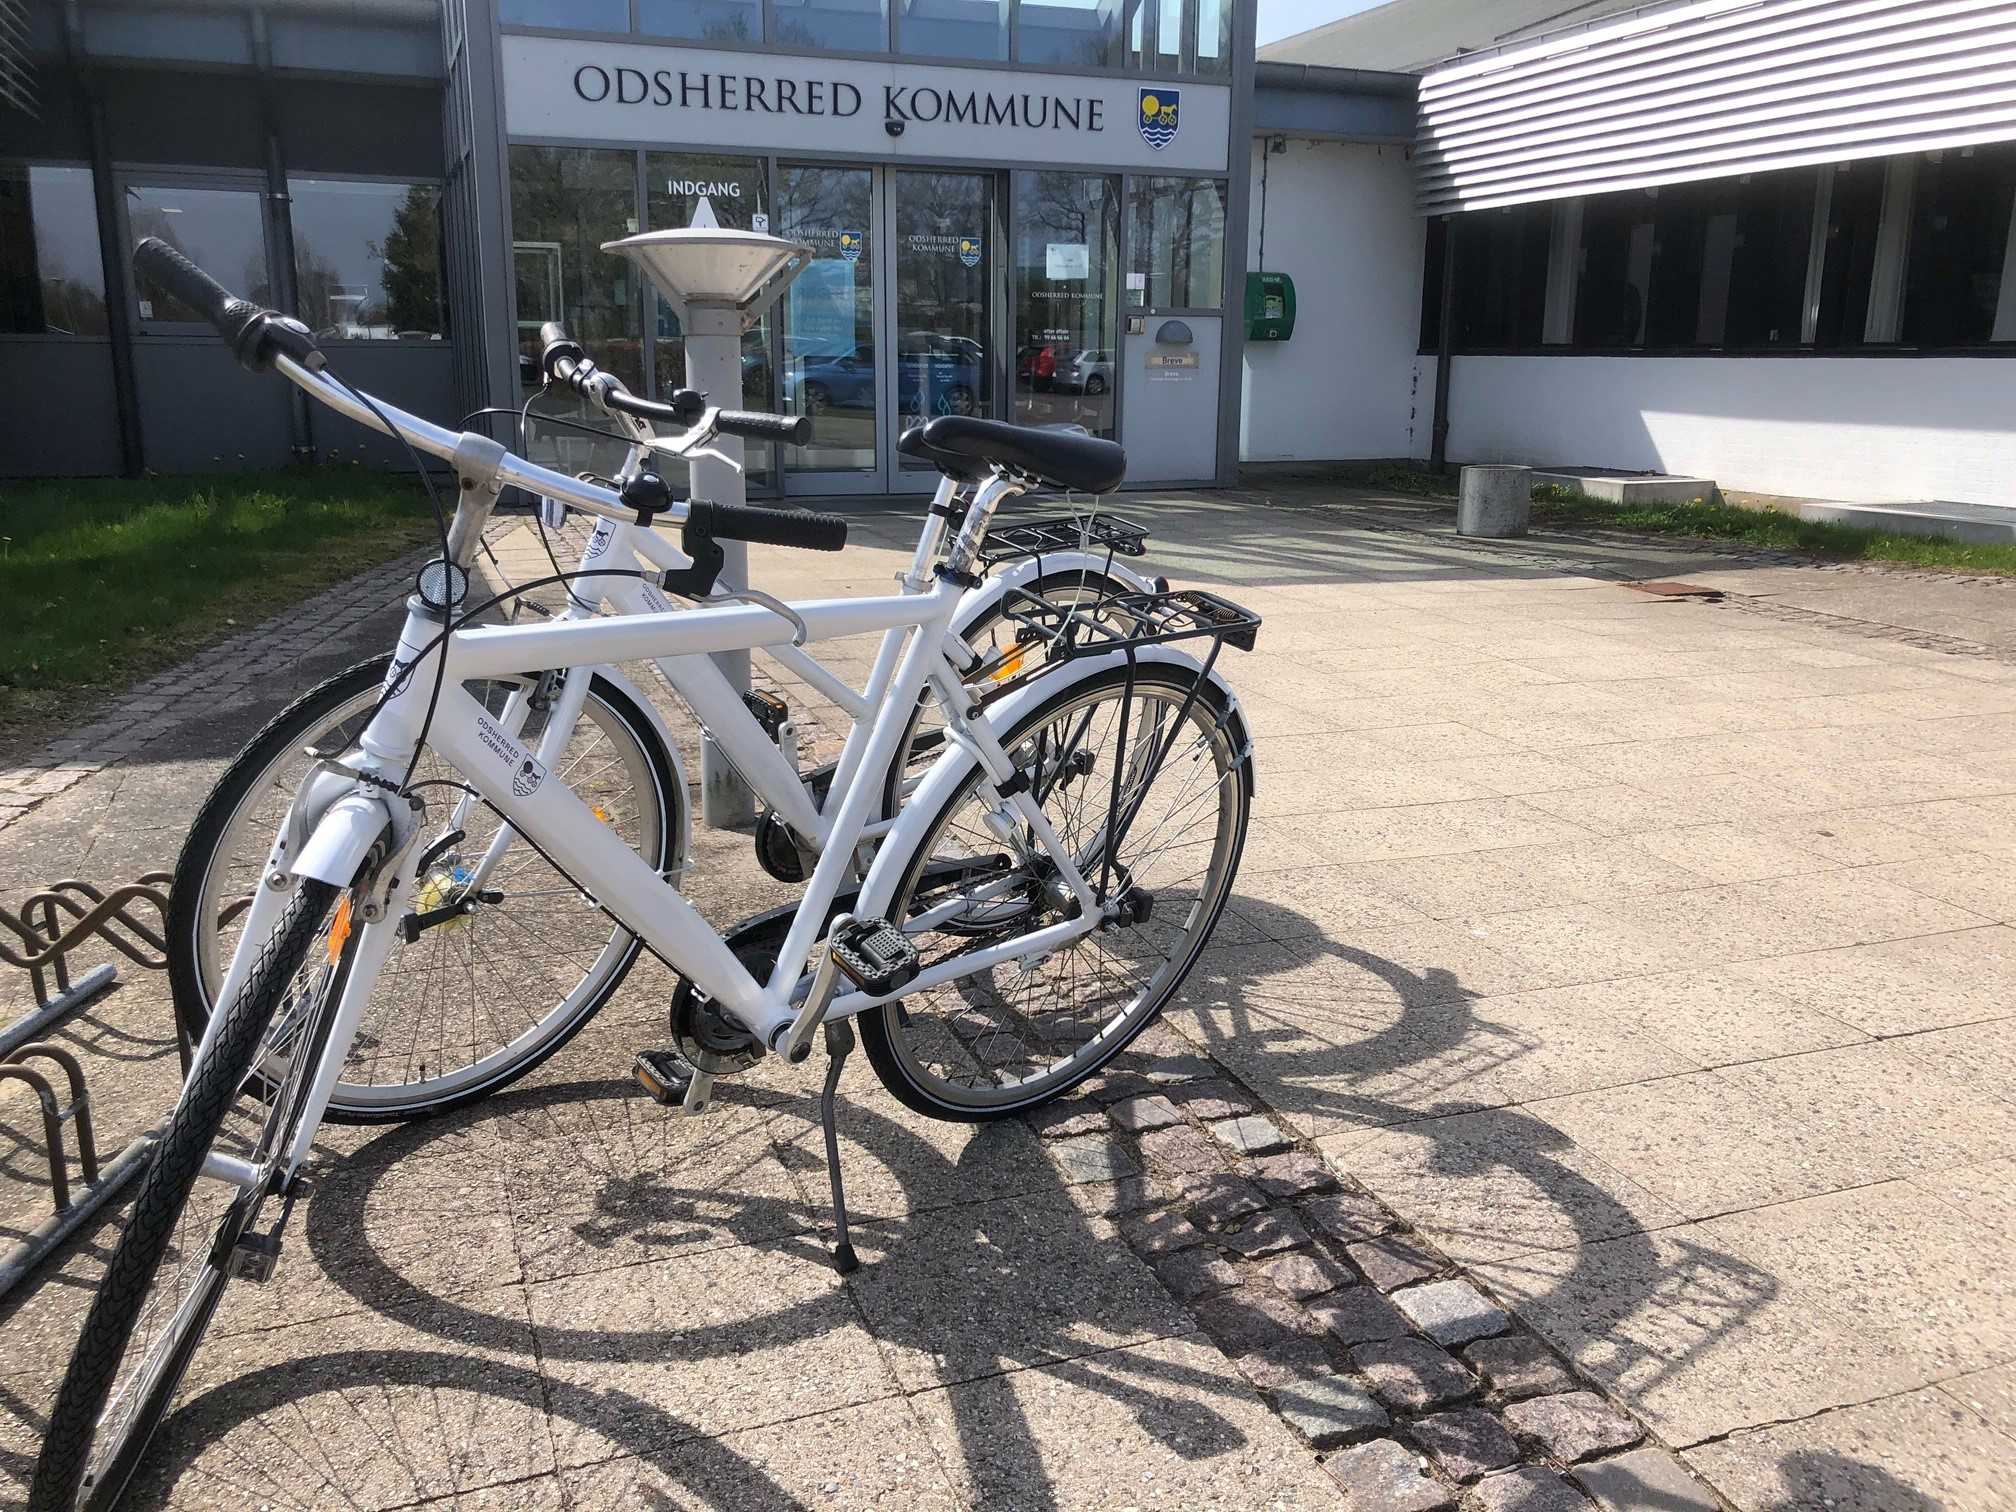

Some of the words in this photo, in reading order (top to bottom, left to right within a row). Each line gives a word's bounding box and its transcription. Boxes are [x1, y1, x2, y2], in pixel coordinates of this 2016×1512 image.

[573, 64, 863, 118] ODSHERRED
[883, 85, 1105, 132] KOMMUNE
[667, 179, 741, 198] INDGANG
[908, 234, 960, 244] ODSHERRED
[912, 244, 955, 253] KOMMUNE
[1162, 355, 1184, 365] Breve
[477, 717, 520, 759] ODSHERRED
[478, 731, 516, 768] KOMMUNE
